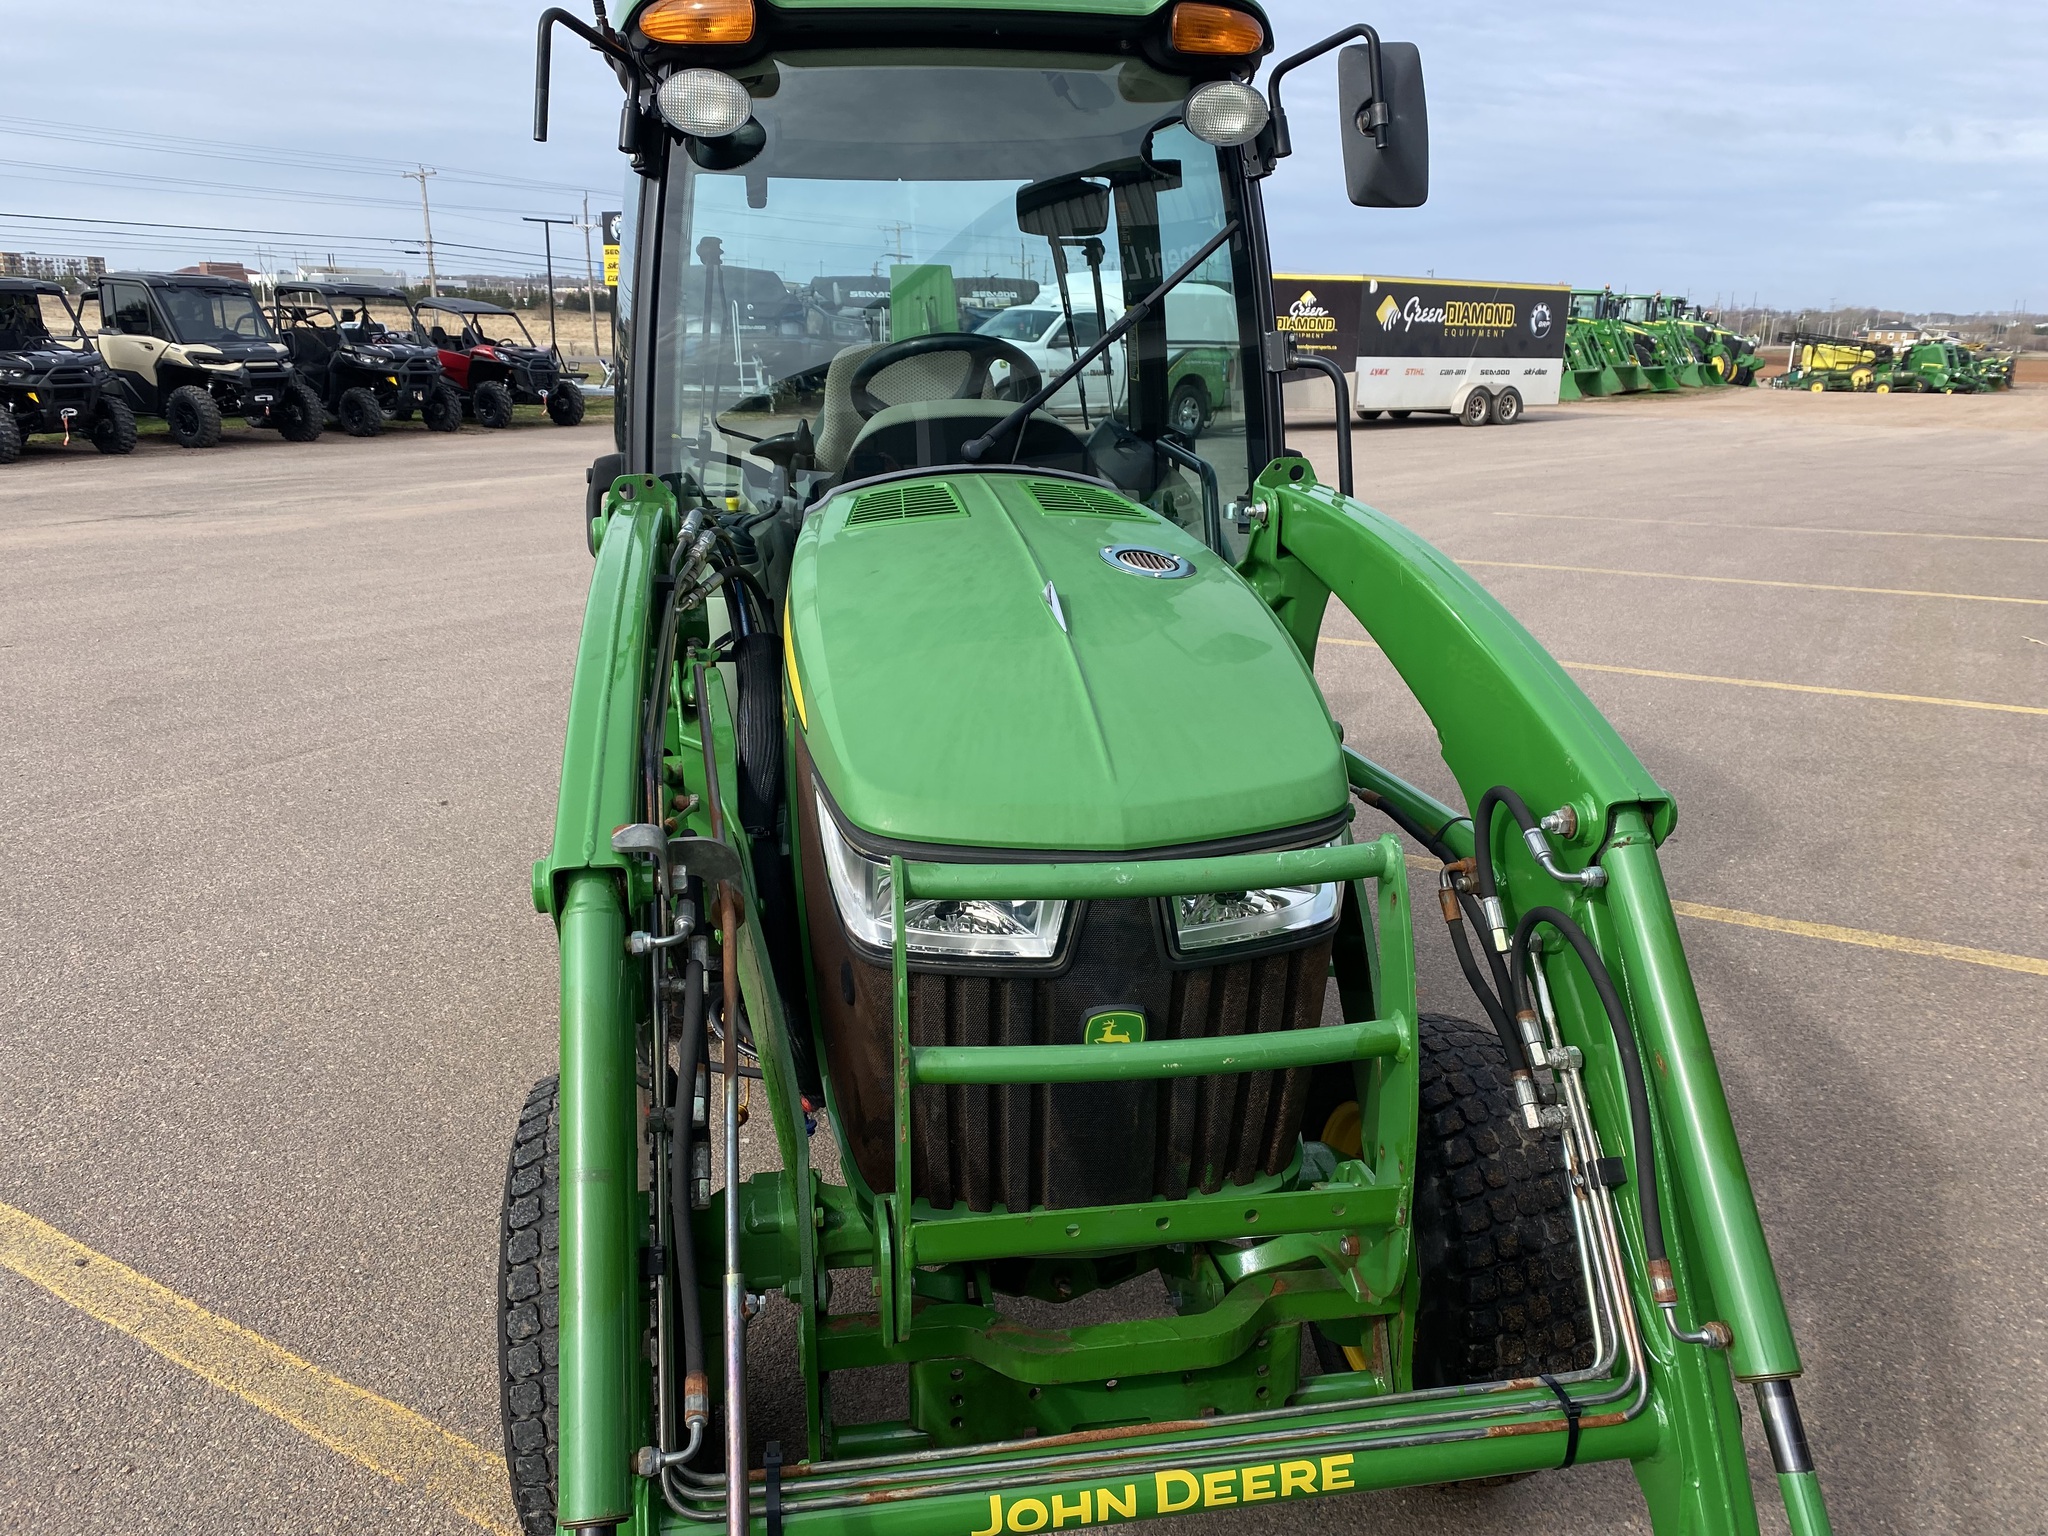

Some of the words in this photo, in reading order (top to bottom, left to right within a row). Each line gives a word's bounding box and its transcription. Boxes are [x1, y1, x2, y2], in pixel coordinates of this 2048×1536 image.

[1289, 300, 1329, 321] Green
[1403, 295, 1447, 333] Green
[1444, 301, 1516, 328] DIAMOND
[1444, 328, 1506, 338] EQUIPMENT
[1369, 367, 1390, 376] LYNX
[1404, 368, 1425, 376] STIHL
[971, 1483, 1138, 1536] JOHN
[1154, 1453, 1355, 1514] DEERE
